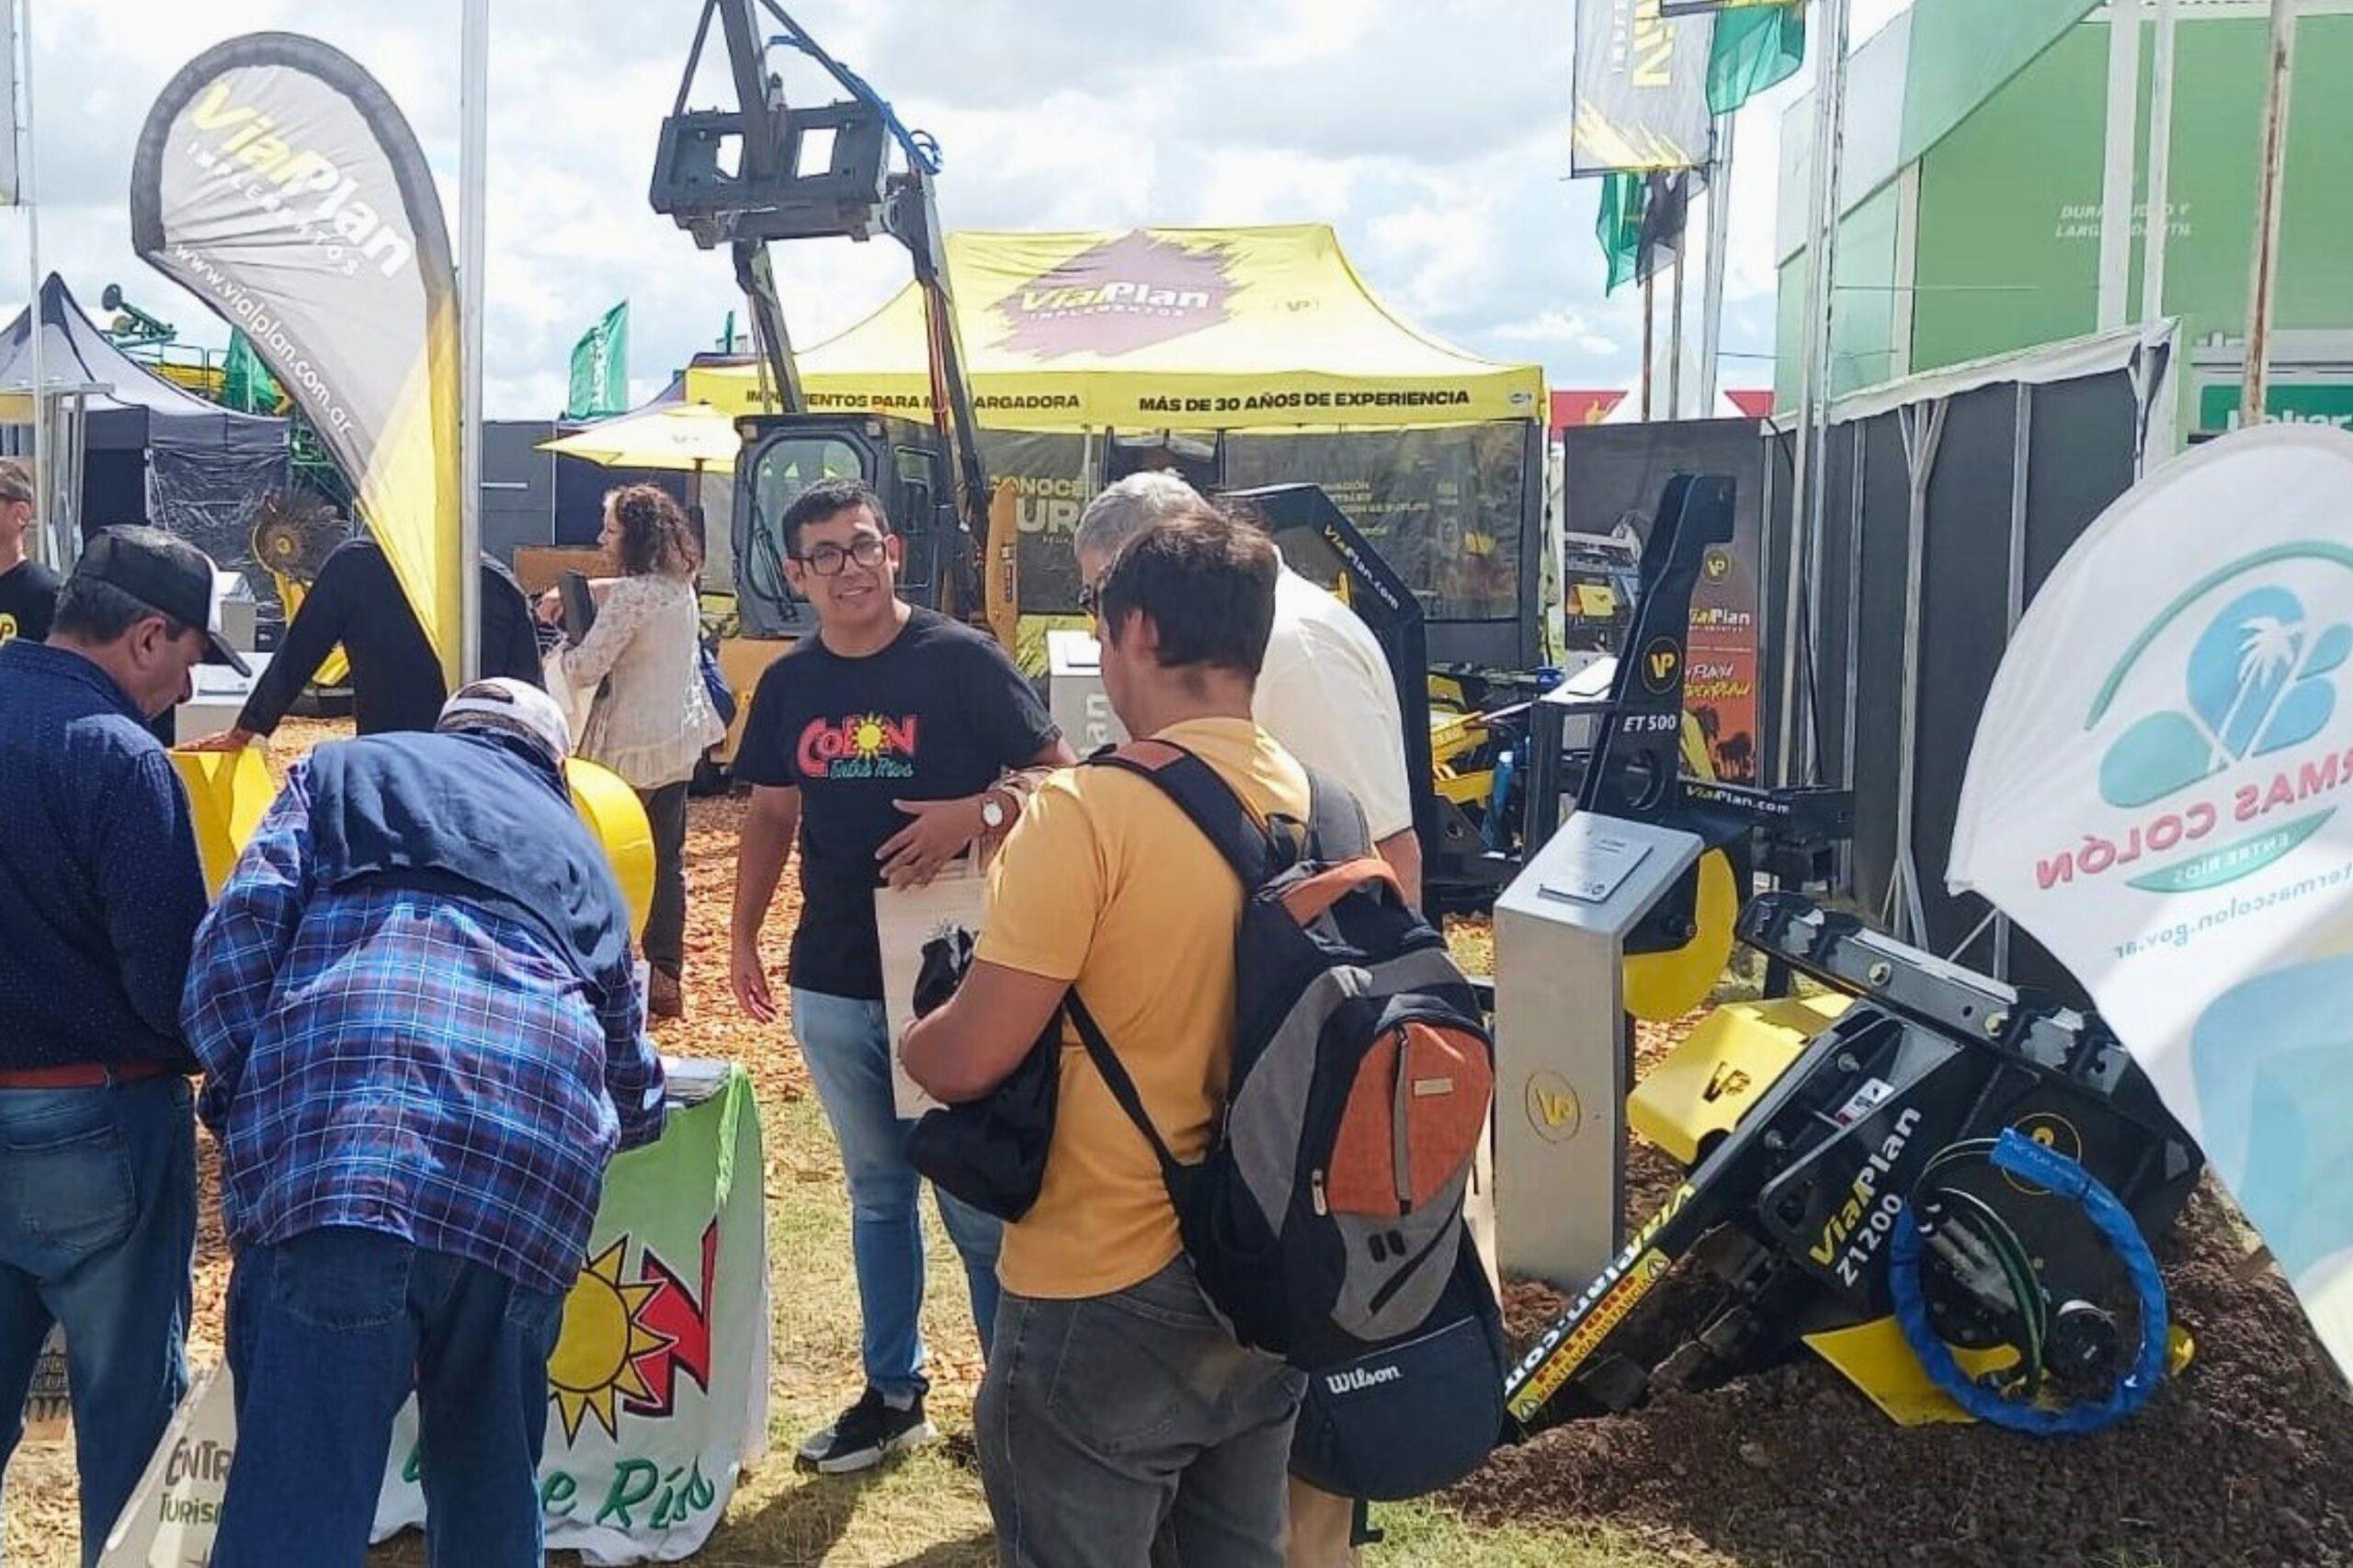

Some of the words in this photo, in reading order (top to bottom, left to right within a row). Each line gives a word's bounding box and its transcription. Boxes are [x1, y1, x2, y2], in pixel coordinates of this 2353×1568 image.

[175, 244, 353, 436] www.vialplan.com.ar
[871, 395, 919, 409] PARA
[1139, 395, 1181, 412] MÁS
[1185, 397, 1211, 412] DE
[1215, 397, 1241, 412] 30
[1245, 391, 1301, 409] AÑOS
[1303, 392, 1331, 406] DE
[1335, 390, 1470, 406] EXPERIENCIA
[1622, 716, 1645, 733] ET
[1648, 714, 1677, 731] 500
[1836, 1194, 1903, 1287] Z1200
[1324, 1366, 1404, 1393] Wilson
[165, 1436, 232, 1486] ENTR
